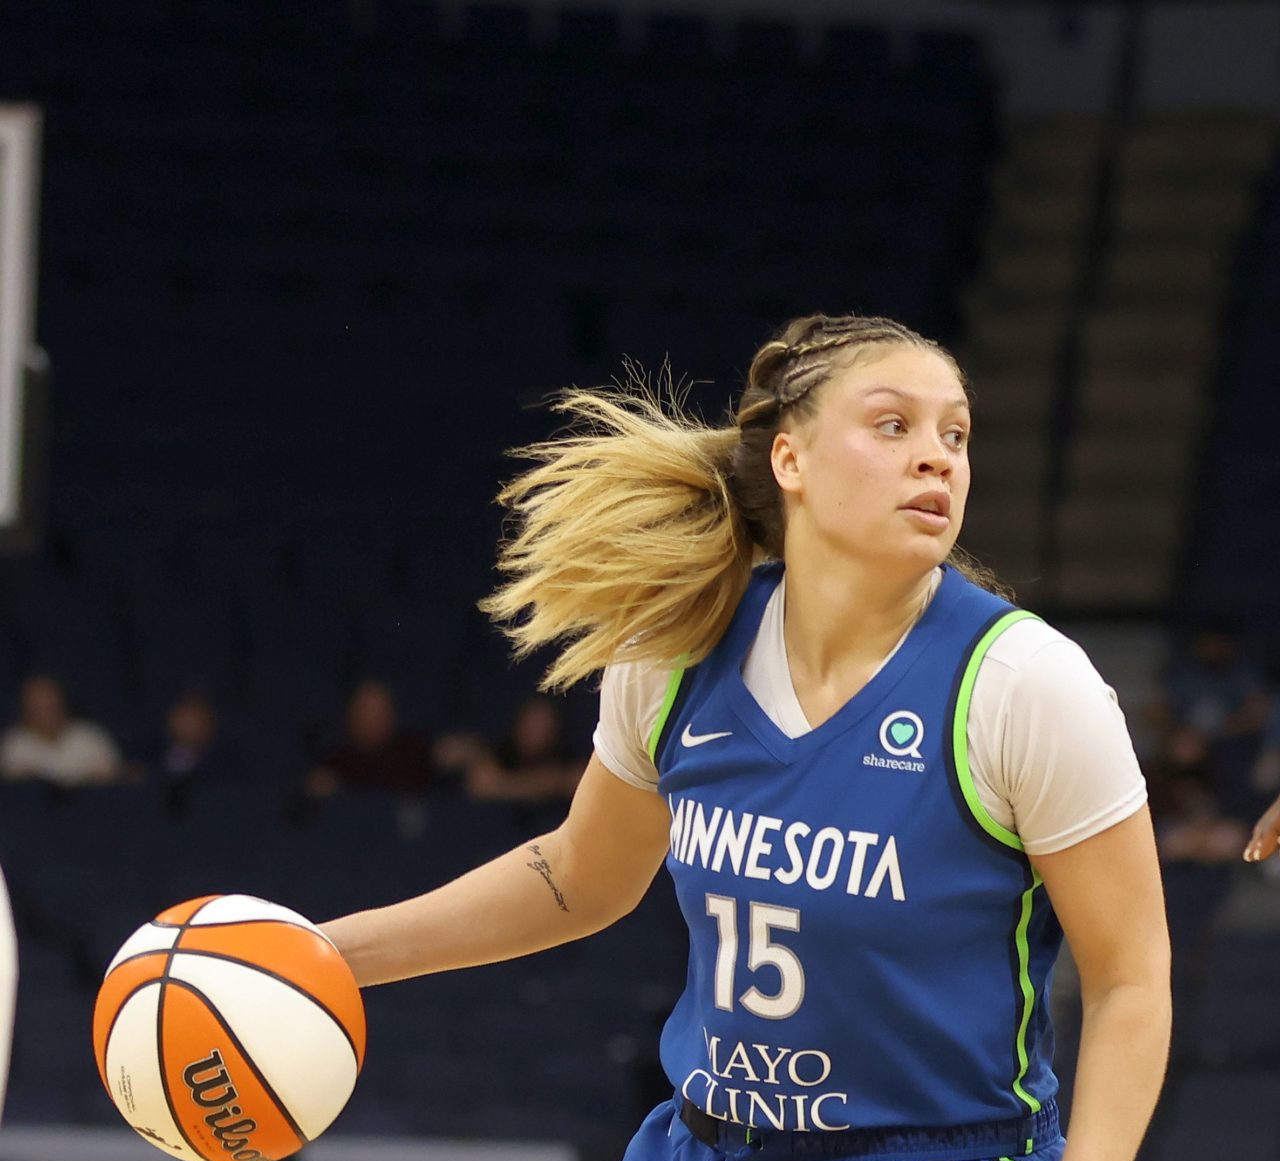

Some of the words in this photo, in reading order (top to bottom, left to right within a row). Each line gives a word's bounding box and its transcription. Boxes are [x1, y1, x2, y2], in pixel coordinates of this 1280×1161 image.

[862, 753, 925, 772] sharecare
[668, 793, 906, 902] MINNESOTA
[704, 892, 805, 1021] 15
[682, 1068, 850, 1132] CLINIC
